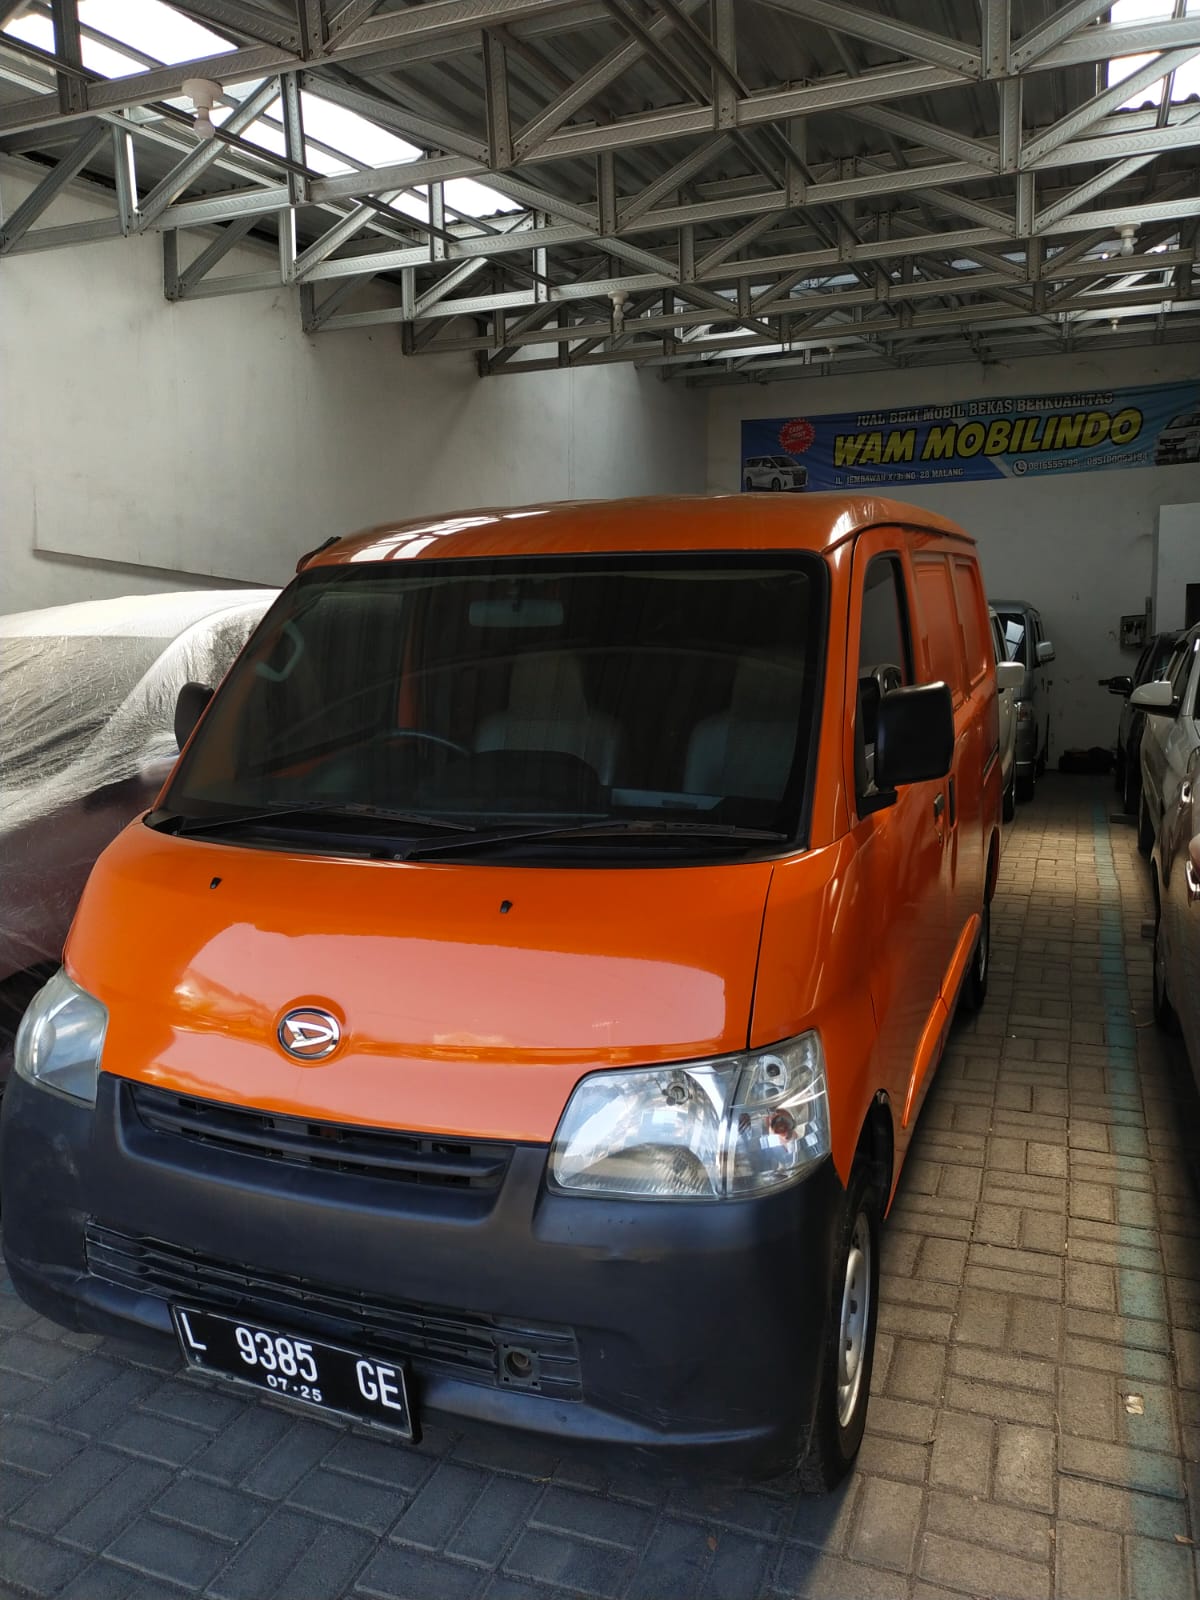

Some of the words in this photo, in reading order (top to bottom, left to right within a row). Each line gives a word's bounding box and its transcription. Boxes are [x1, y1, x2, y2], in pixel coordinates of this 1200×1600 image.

[857, 413, 885, 427] JUAL
[889, 410, 920, 424] BELI
[923, 405, 965, 421] MOBIL
[968, 399, 1013, 417] BEKAS
[1016, 392, 1114, 412] BERKUALITAS
[834, 429, 916, 467] WAM
[920, 407, 1143, 460] MOBILINDO
[931, 467, 964, 478] MALANG
[181, 1311, 207, 1351] L
[235, 1326, 318, 1382] 9385
[356, 1360, 402, 1411] GE
